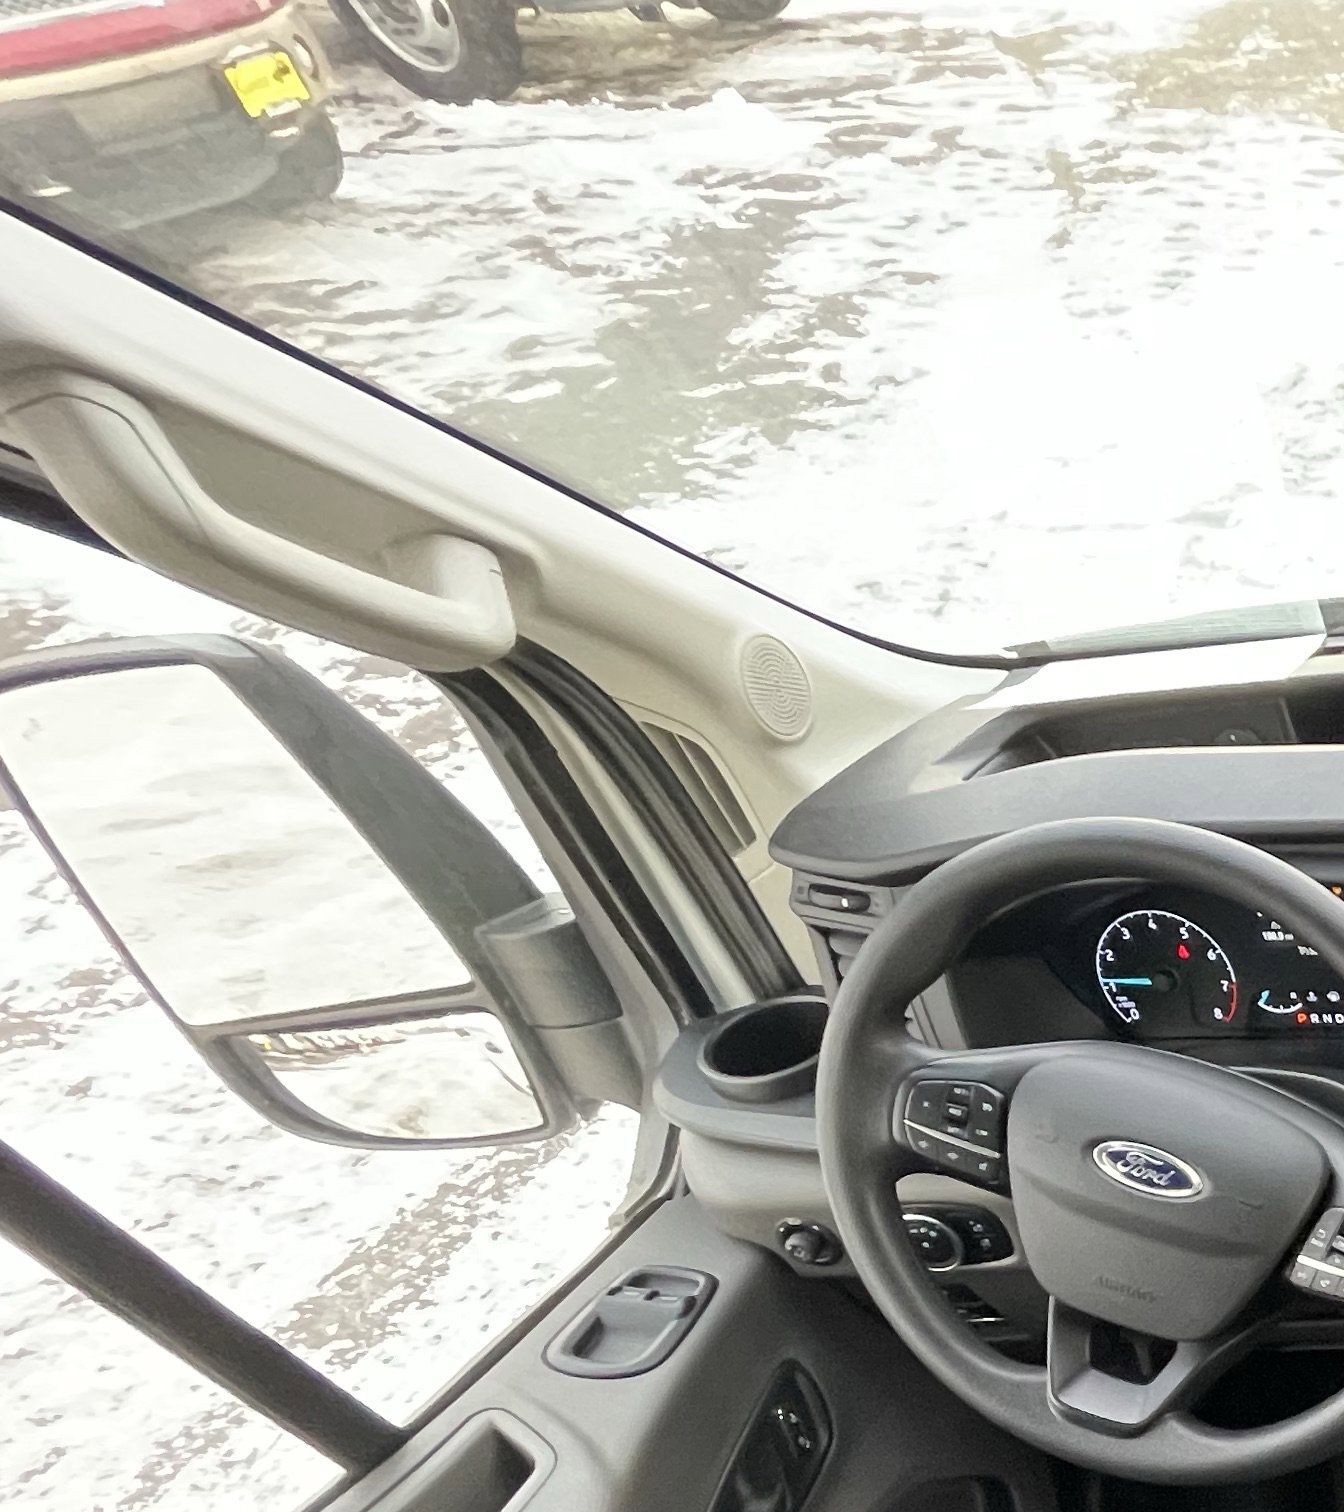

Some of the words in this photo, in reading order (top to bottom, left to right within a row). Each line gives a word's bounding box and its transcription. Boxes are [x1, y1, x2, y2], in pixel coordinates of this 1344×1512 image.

[1148, 919, 1157, 930] 4
[1122, 927, 1131, 939] 3
[1179, 927, 1189, 939] 5
[1104, 950, 1114, 961] 2
[1207, 948, 1216, 960] 6
[1220, 980, 1229, 992] 7
[1213, 1007, 1223, 1019] 8
[1116, 1151, 1176, 1186] Ford
